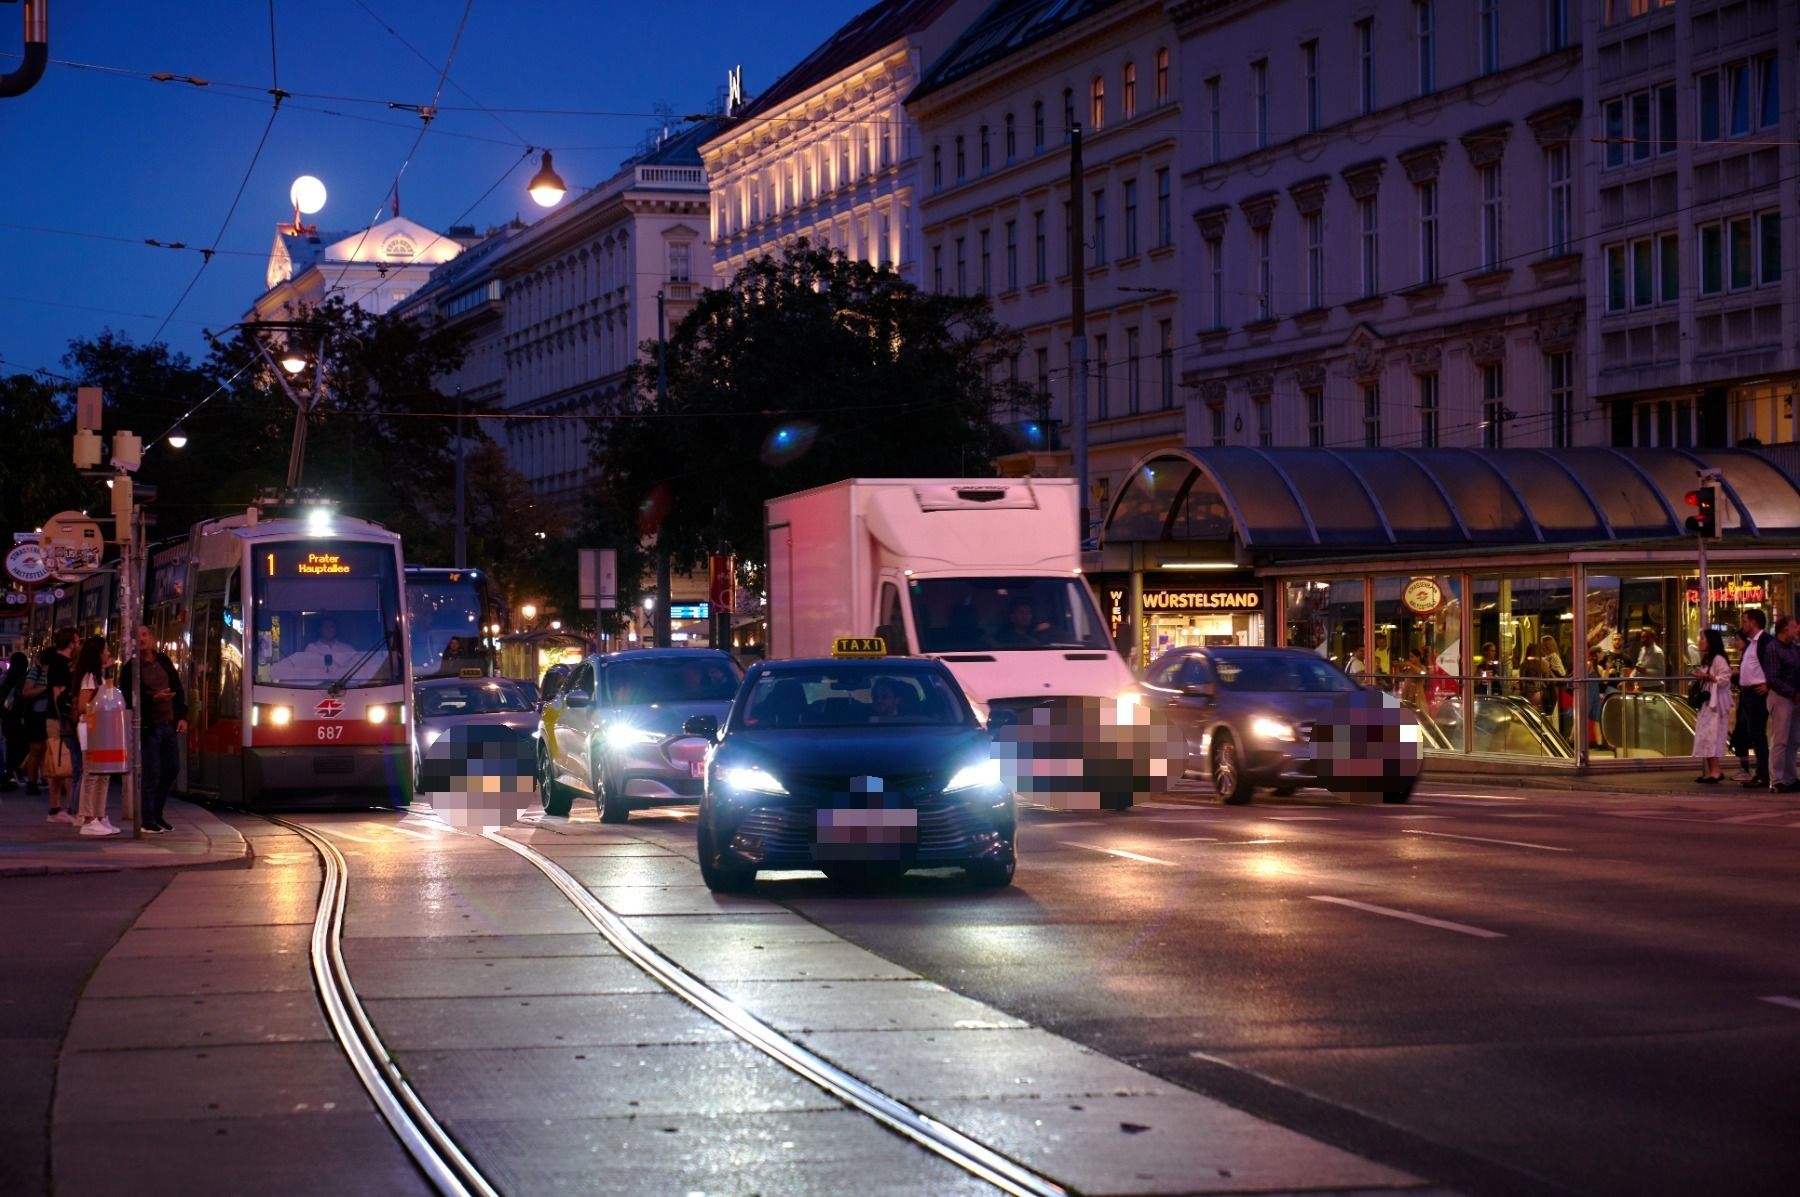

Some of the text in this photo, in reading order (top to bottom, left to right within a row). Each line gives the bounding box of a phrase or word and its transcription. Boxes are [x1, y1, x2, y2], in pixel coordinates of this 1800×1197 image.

[267, 553, 274, 576] 1
[308, 553, 340, 563] Prater
[11, 566, 49, 579] HALTESTELL
[298, 564, 351, 575] Hauptallee
[1142, 591, 1260, 608] WÜRSTELSTAND
[839, 639, 880, 651] TAXI
[317, 725, 344, 740] 687
